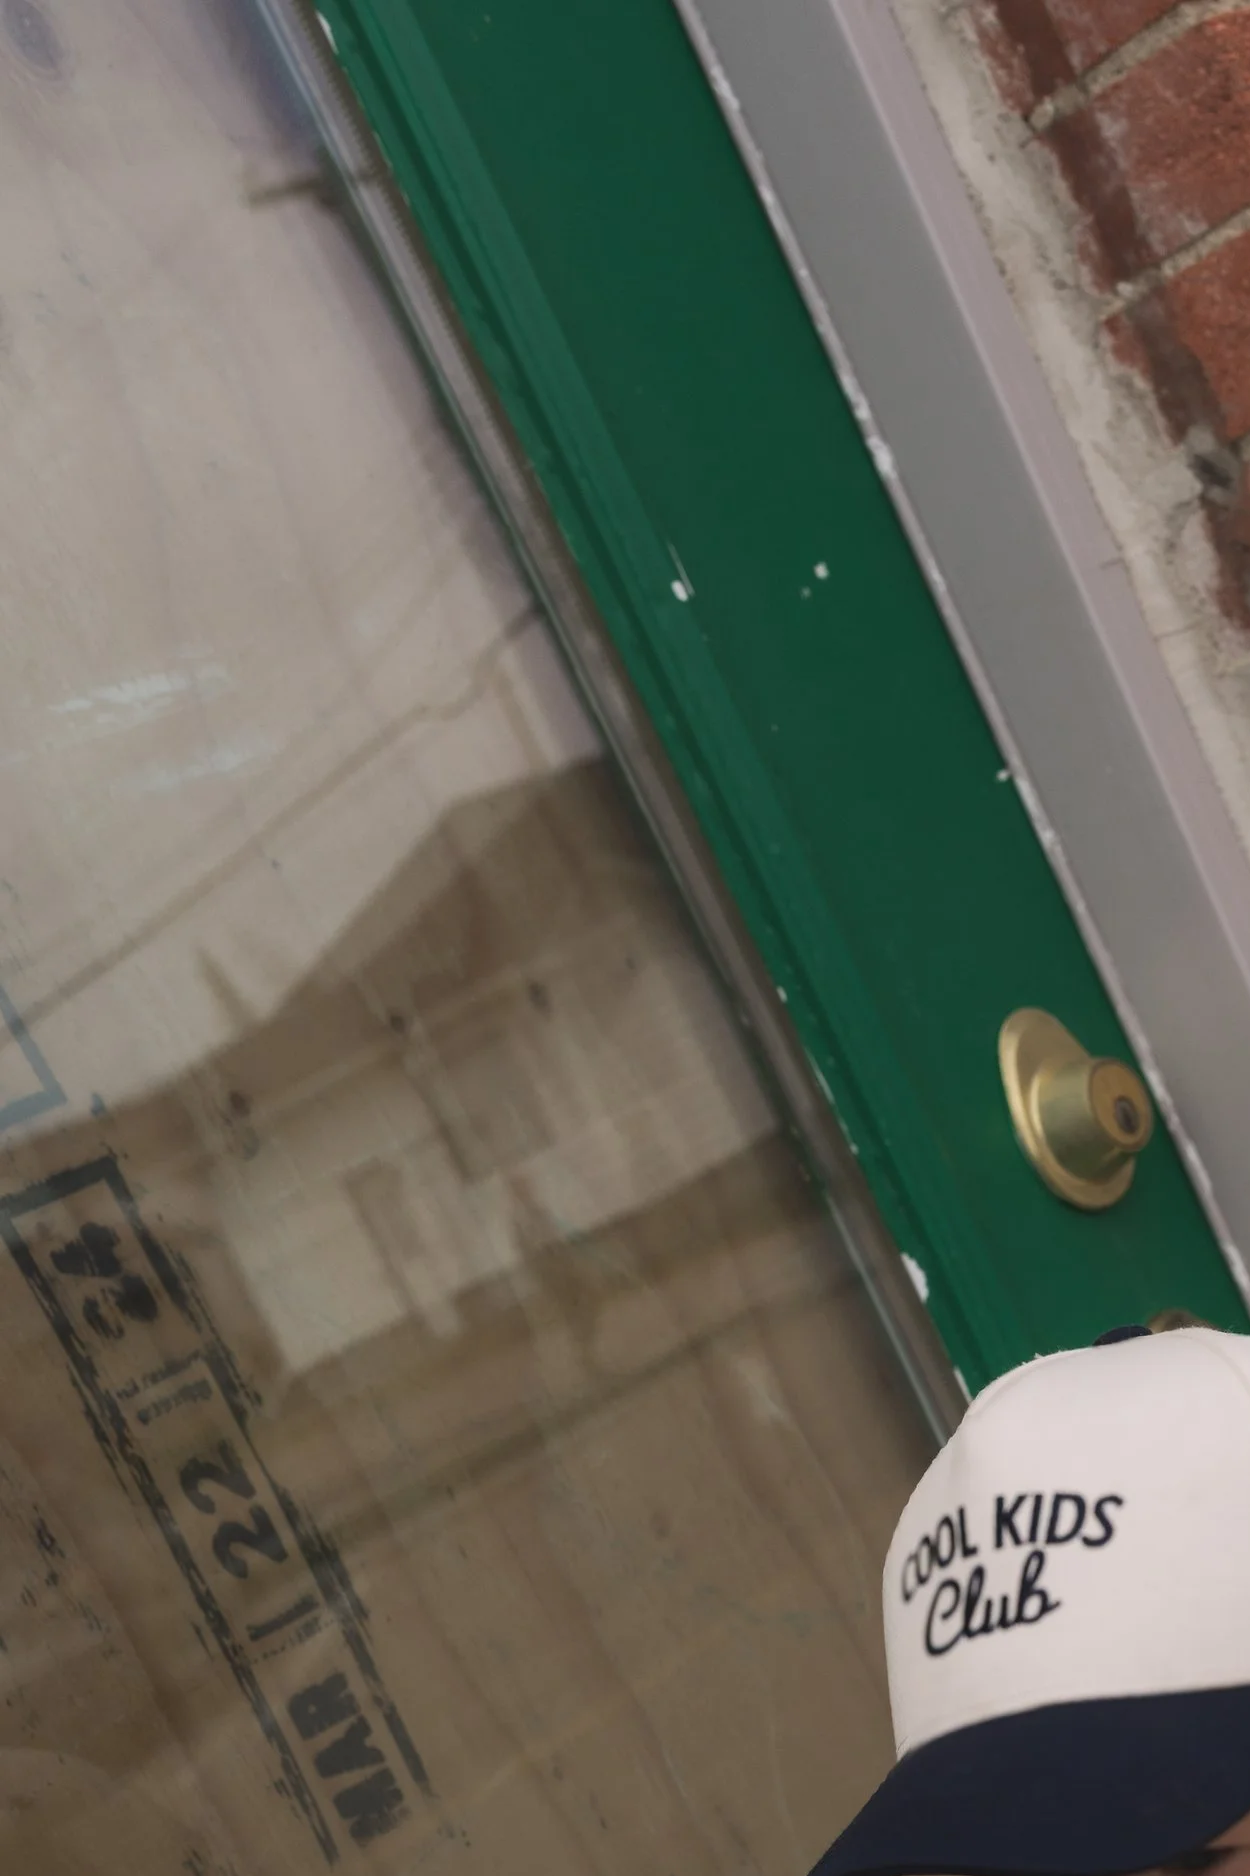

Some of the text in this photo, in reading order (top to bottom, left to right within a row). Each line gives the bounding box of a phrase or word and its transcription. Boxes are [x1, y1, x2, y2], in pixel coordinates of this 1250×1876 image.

[178, 1436, 288, 1580] 22
[901, 1492, 1124, 1604] COOL KIDS
[923, 1549, 1061, 1657] Club
[288, 1670, 407, 1847] MAR
